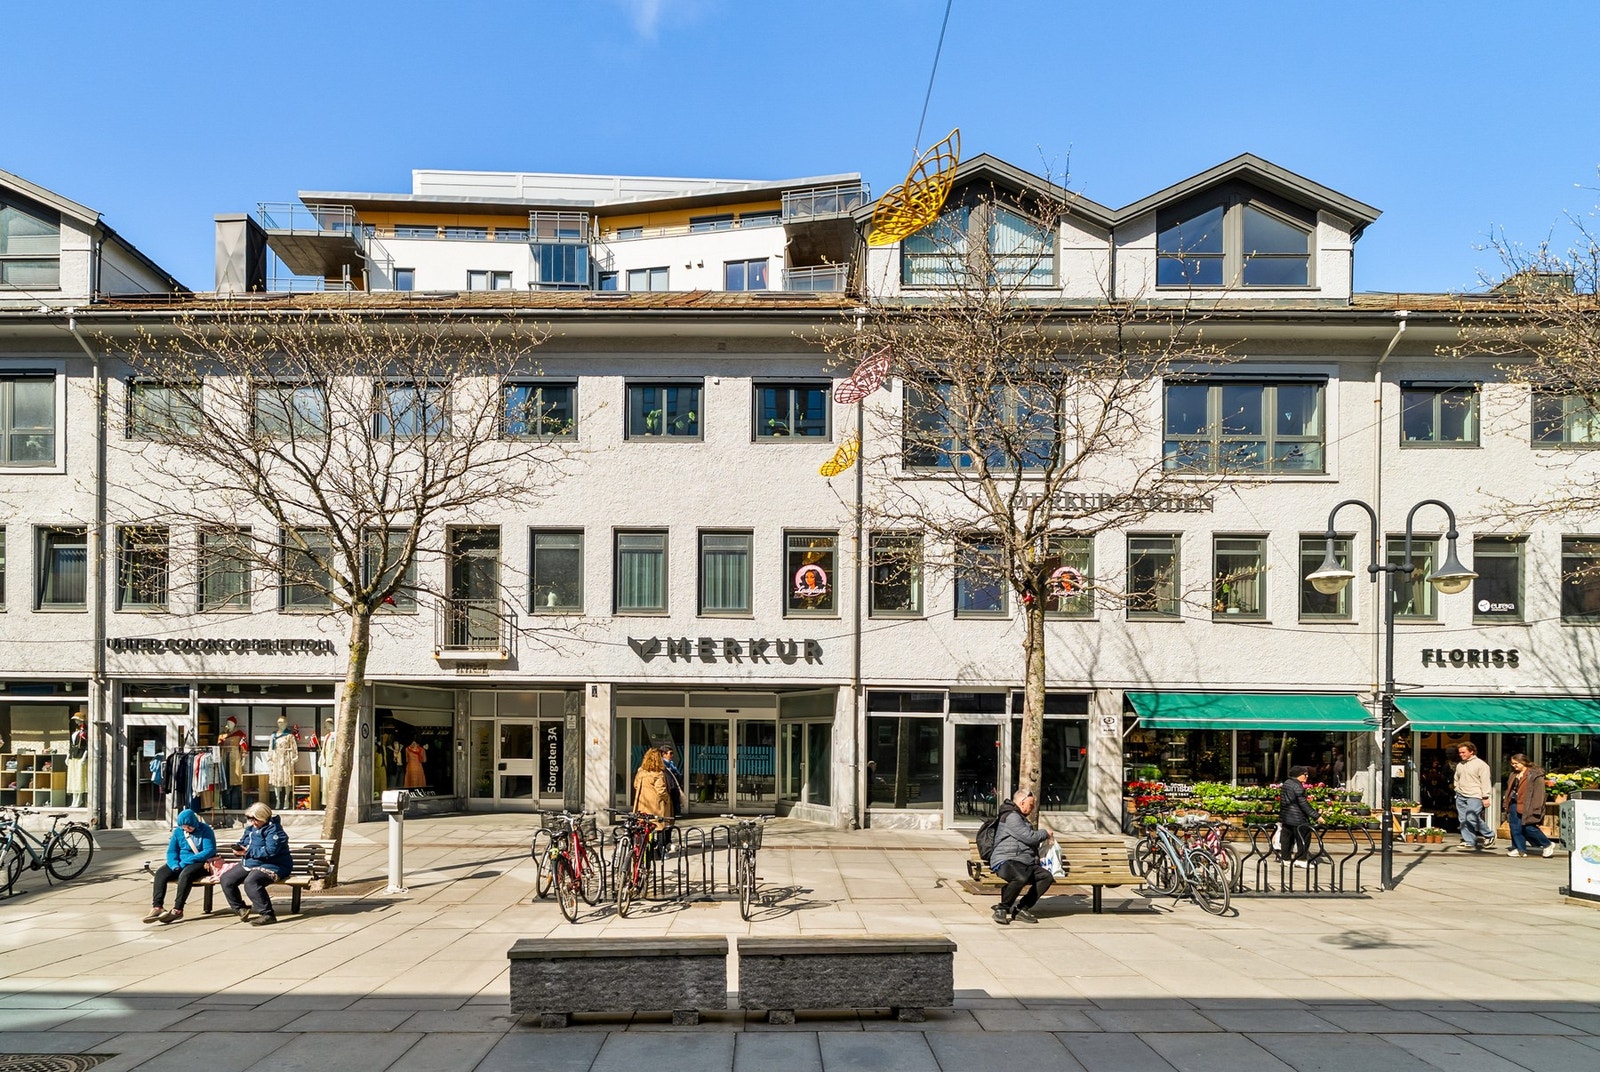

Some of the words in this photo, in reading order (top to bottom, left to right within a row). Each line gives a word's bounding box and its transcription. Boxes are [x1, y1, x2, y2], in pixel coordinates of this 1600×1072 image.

[165, 638, 224, 653] COLORS
[228, 639, 250, 653] OF
[667, 636, 822, 663] MERKUR
[1422, 648, 1519, 665] FLORISS
[548, 726, 558, 741] 3A
[547, 743, 559, 793] Storgaten
